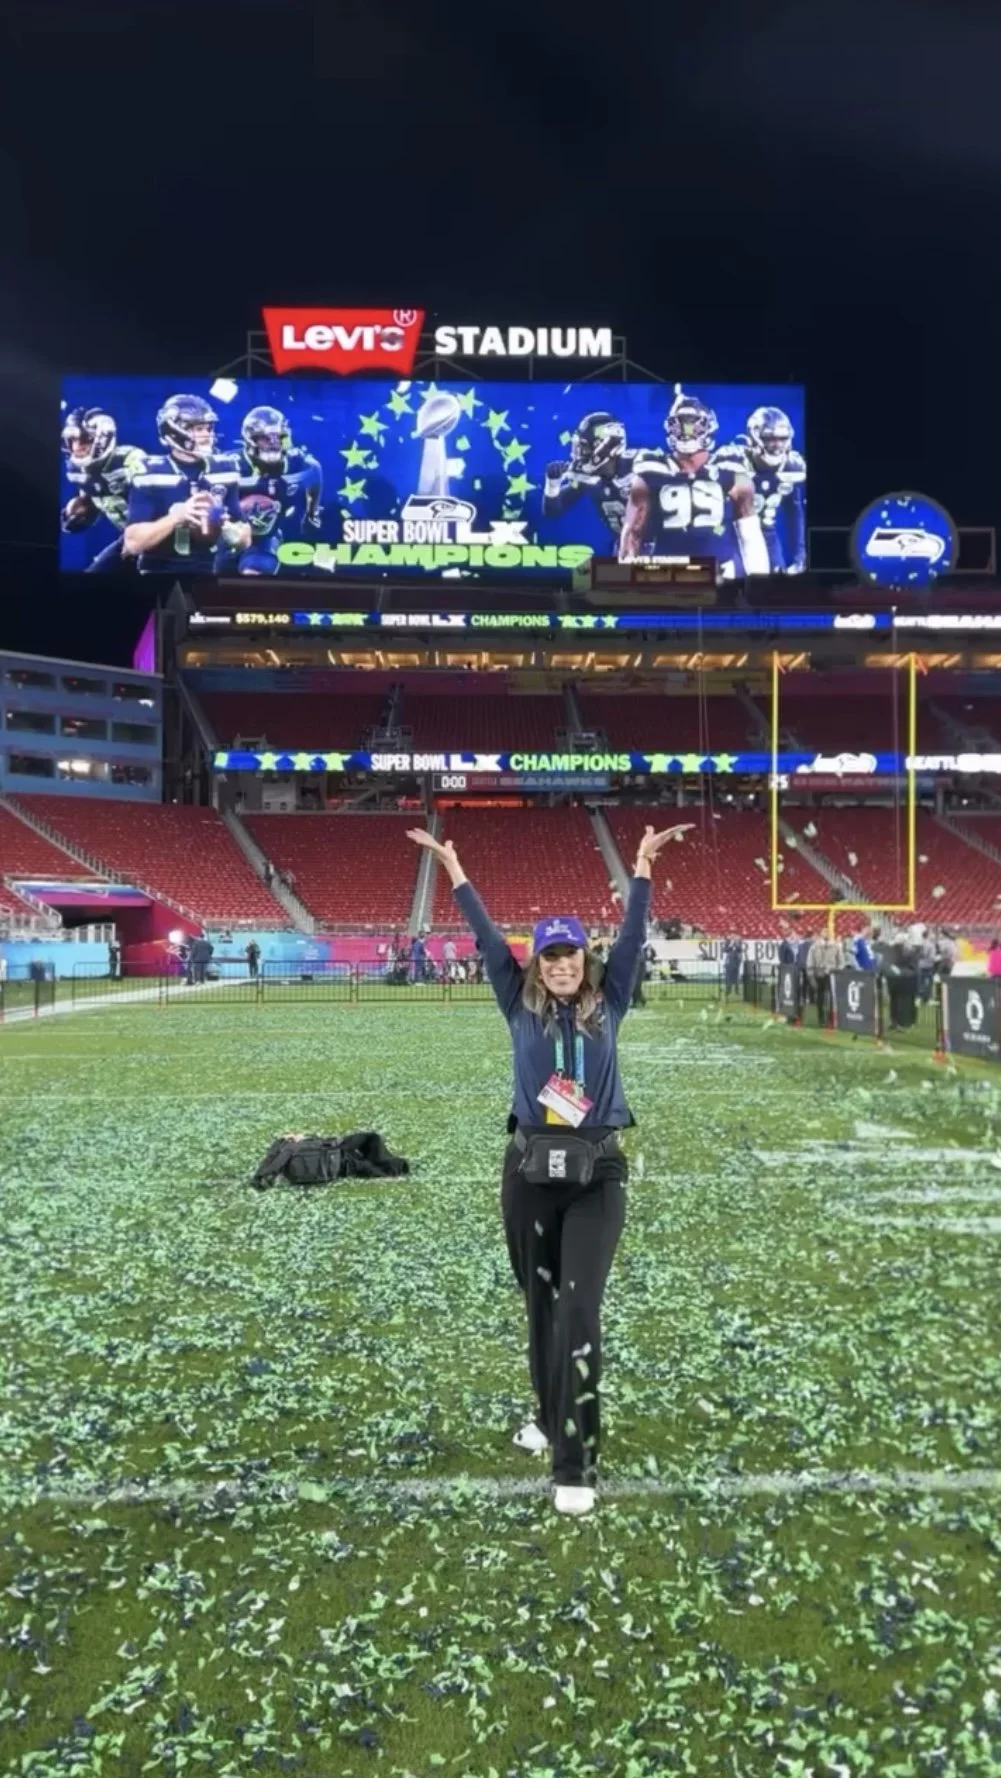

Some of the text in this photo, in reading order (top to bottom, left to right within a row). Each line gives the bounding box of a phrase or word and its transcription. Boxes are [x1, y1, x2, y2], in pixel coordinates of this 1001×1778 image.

[435, 326, 612, 357] STADIUM
[659, 480, 724, 529] 99
[343, 520, 528, 544] SUPER BOWL LX
[277, 542, 594, 569] CHAMPIONS
[235, 612, 290, 625] $579,140
[470, 614, 551, 627] CHAMPIONS
[370, 753, 503, 772] SUPER BOWL LX
[509, 753, 632, 772] CHAMPIONS
